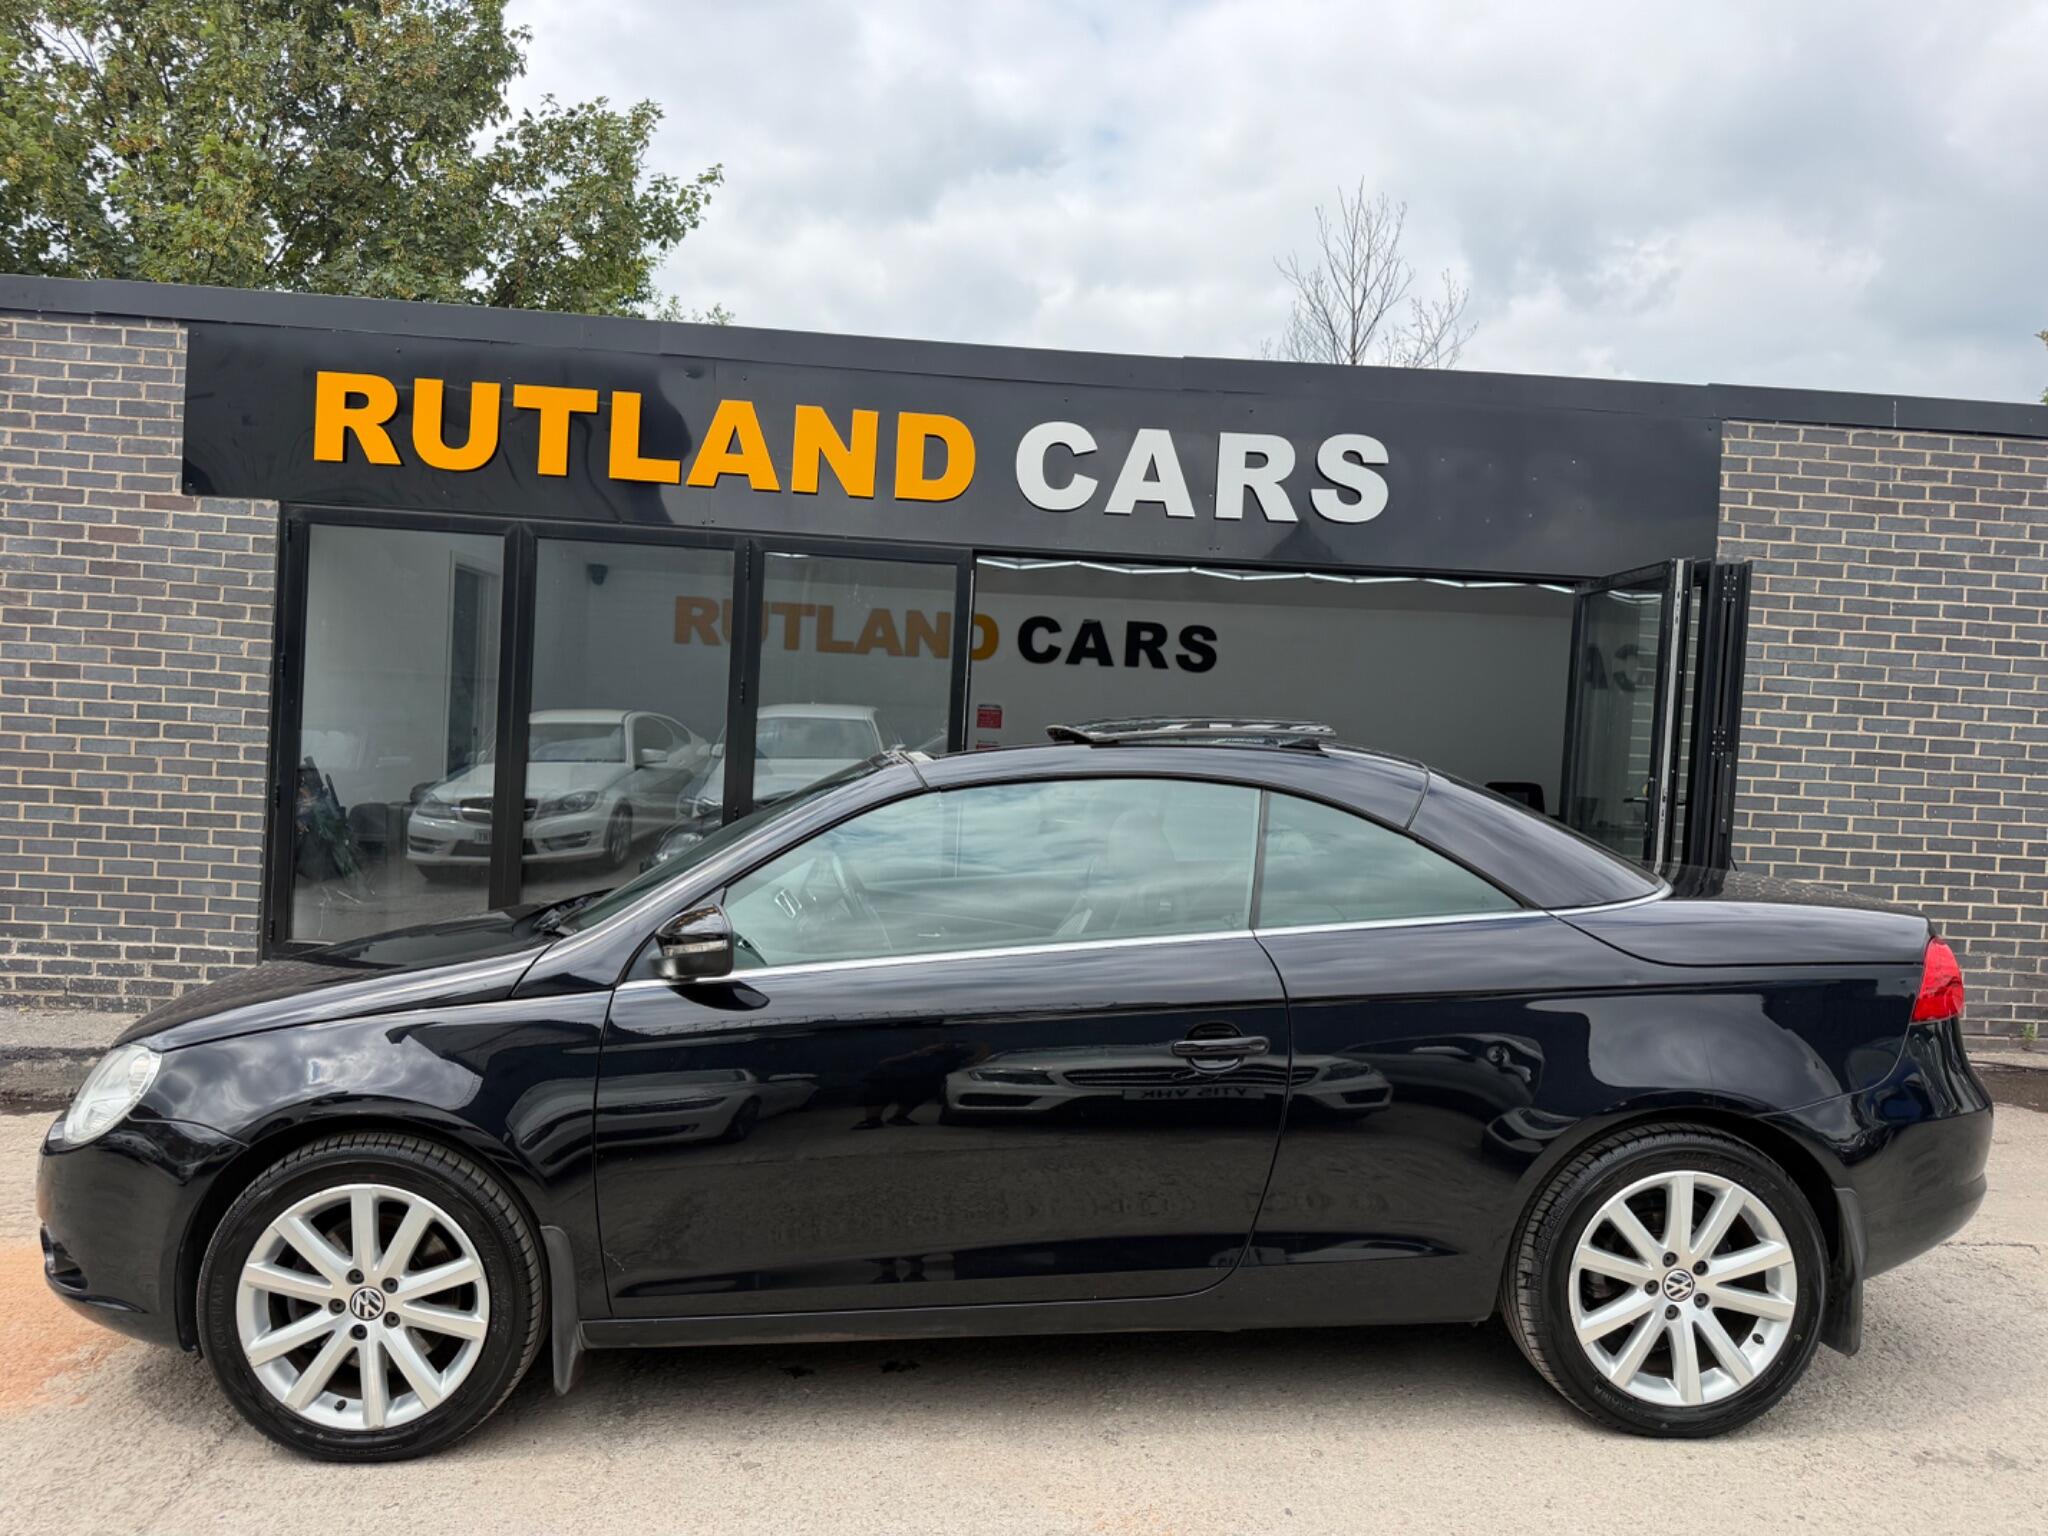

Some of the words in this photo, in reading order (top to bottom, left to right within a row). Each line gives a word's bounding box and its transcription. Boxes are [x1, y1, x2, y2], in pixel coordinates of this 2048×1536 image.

[313, 370, 977, 502] RUTLAND
[1015, 421, 1390, 524] CARS
[1017, 615, 1218, 673] CARS
